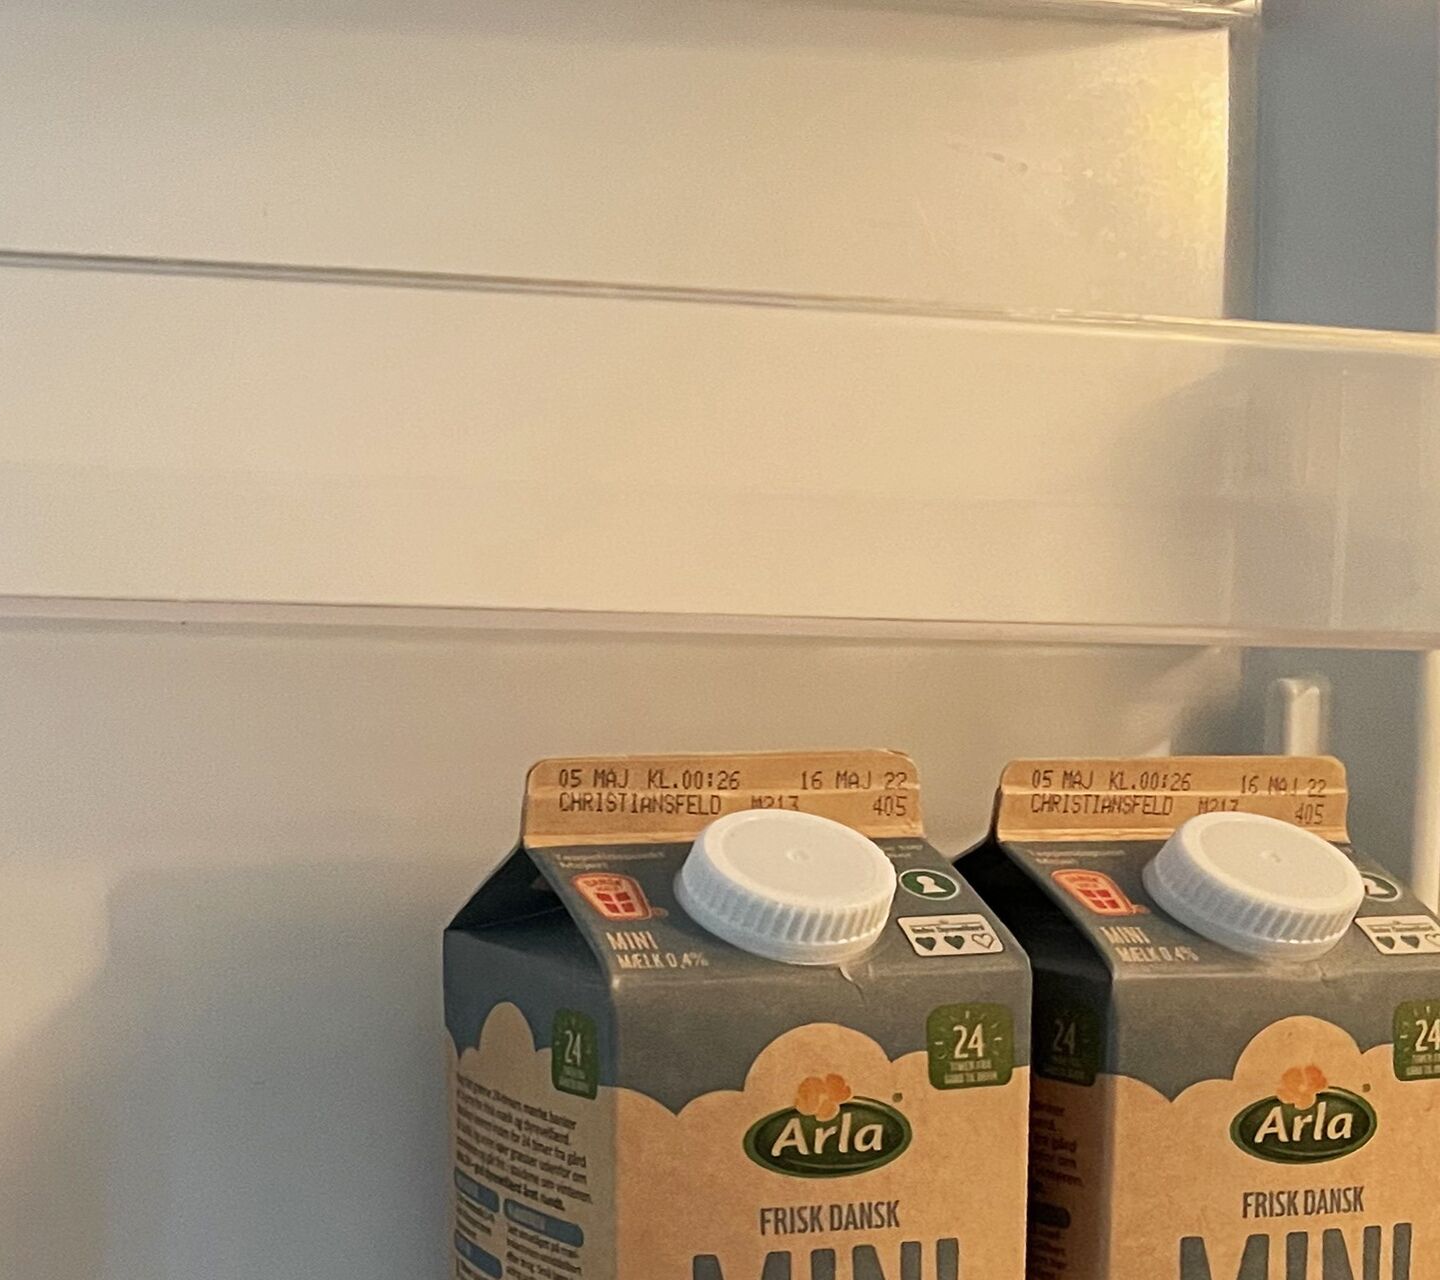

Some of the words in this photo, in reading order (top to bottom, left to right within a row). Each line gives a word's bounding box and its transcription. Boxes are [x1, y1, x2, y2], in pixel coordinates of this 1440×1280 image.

[559, 769, 582, 789] 05
[593, 769, 629, 789] MAJ
[801, 771, 822, 789] 16
[835, 771, 871, 790] MAJ
[884, 772, 908, 791] 22
[1032, 770, 1053, 789] 05
[1062, 771, 1094, 790] MAJ
[1242, 775, 1258, 793] 16
[560, 792, 721, 815] CHRISTIANSFELD
[873, 795, 907, 816] 405
[1031, 793, 1173, 816] CHRISTIANSFELD
[1295, 803, 1324, 826] 405
[606, 930, 658, 951] MINI
[564, 1029, 581, 1067] 24
[953, 1023, 984, 1059] 24
[770, 1111, 884, 1157] Arla
[1254, 1104, 1353, 1143] Arla
[1242, 1189, 1298, 1218] FRISK
[1303, 1185, 1365, 1216] DANSK
[760, 1205, 823, 1235] FRISK
[830, 1200, 900, 1230] DANSK
